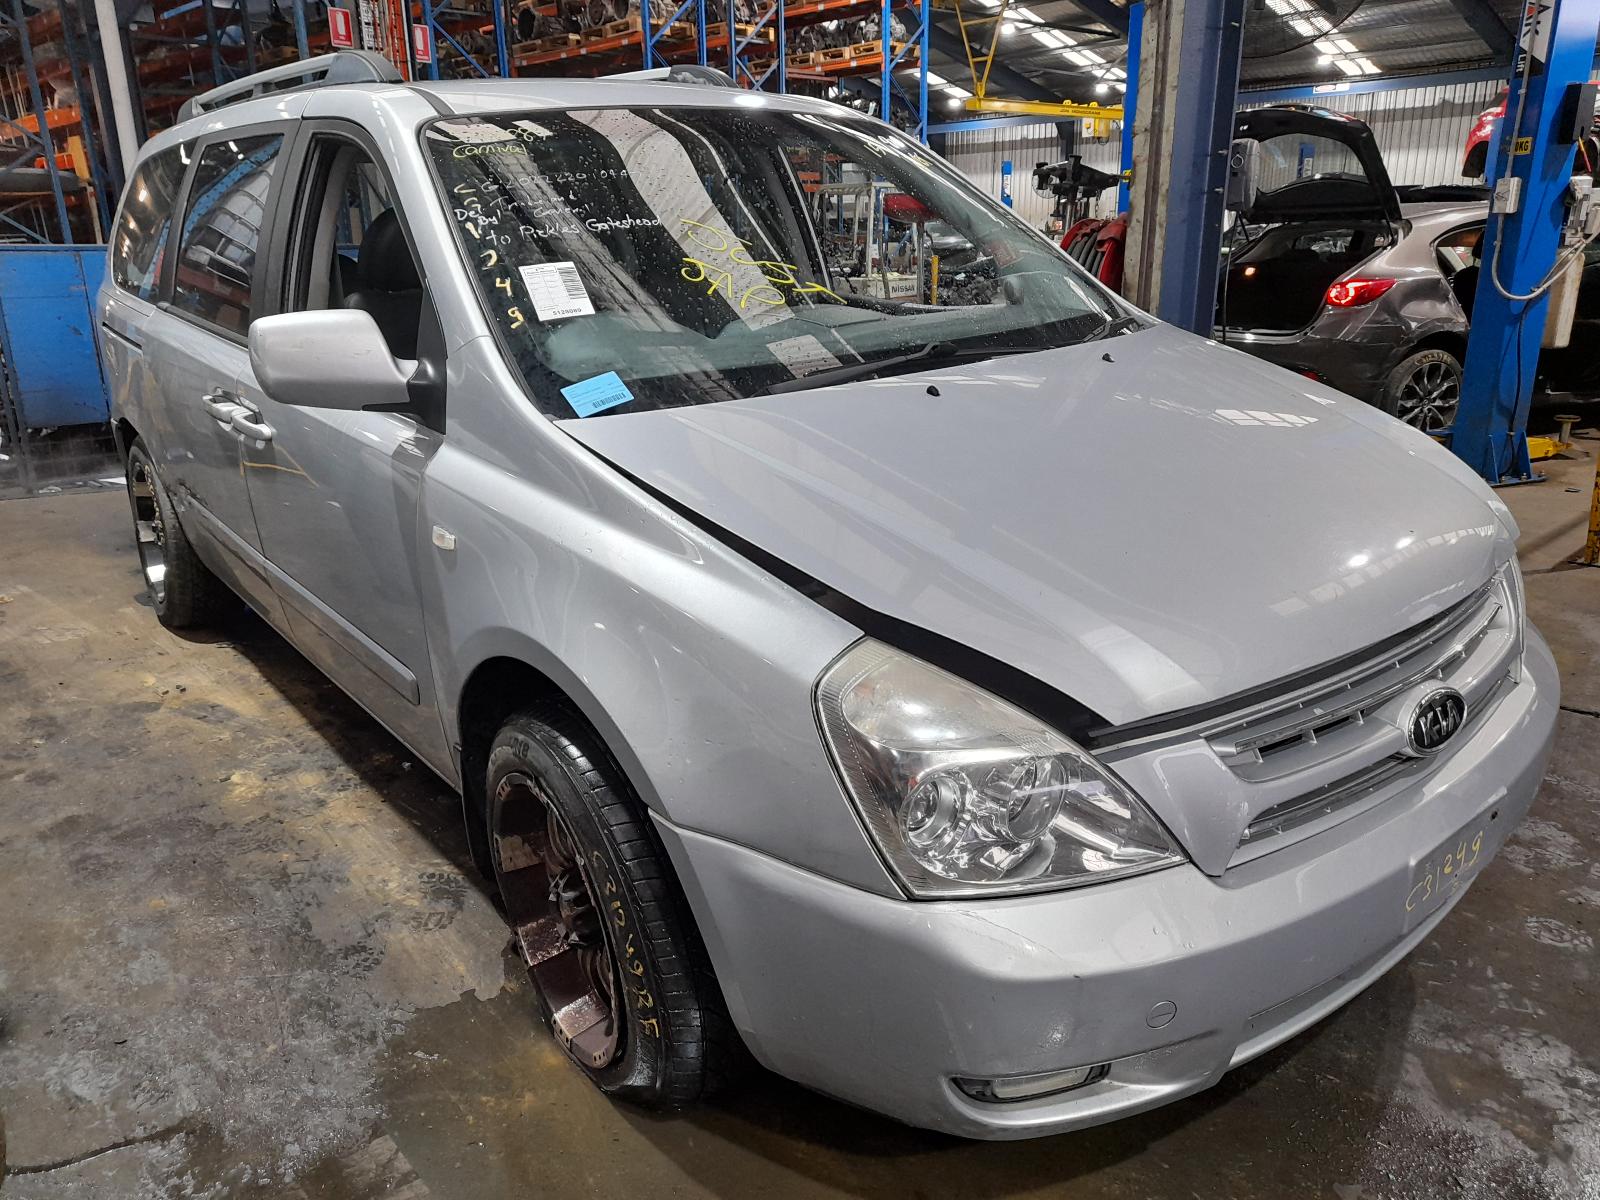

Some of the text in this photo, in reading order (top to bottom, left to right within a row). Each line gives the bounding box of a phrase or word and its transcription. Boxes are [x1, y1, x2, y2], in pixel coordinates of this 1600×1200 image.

[585, 213, 662, 233] Gateshead
[1418, 699, 1461, 746] KIA
[1405, 831, 1483, 912] C31249
